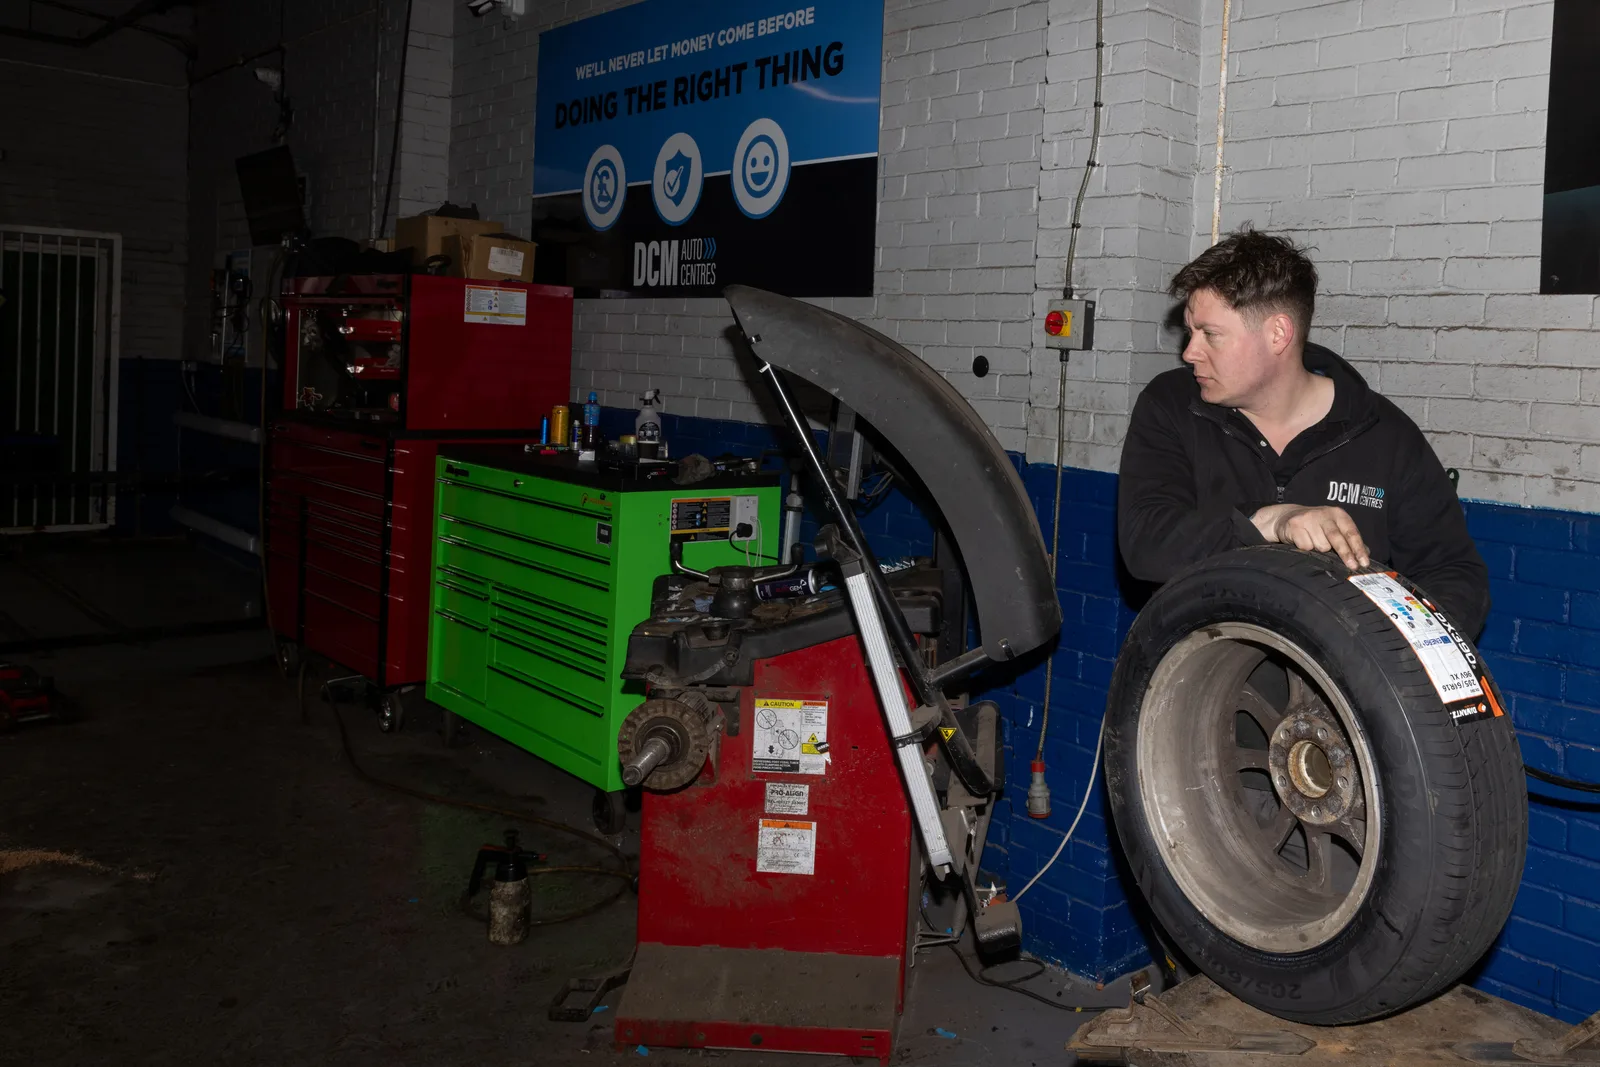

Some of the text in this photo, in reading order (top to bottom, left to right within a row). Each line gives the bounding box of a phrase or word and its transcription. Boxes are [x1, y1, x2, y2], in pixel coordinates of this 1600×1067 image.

[575, 6, 815, 81] WE'LL NEVER LET MONEY COME BEFORE
[555, 41, 844, 129] DOING THE RIGHT THING
[633, 238, 703, 287] DCM AUTO
[680, 262, 717, 286] CENTRES
[1326, 481, 1376, 504] DCM AUTO
[1359, 495, 1384, 509] CENTRES
